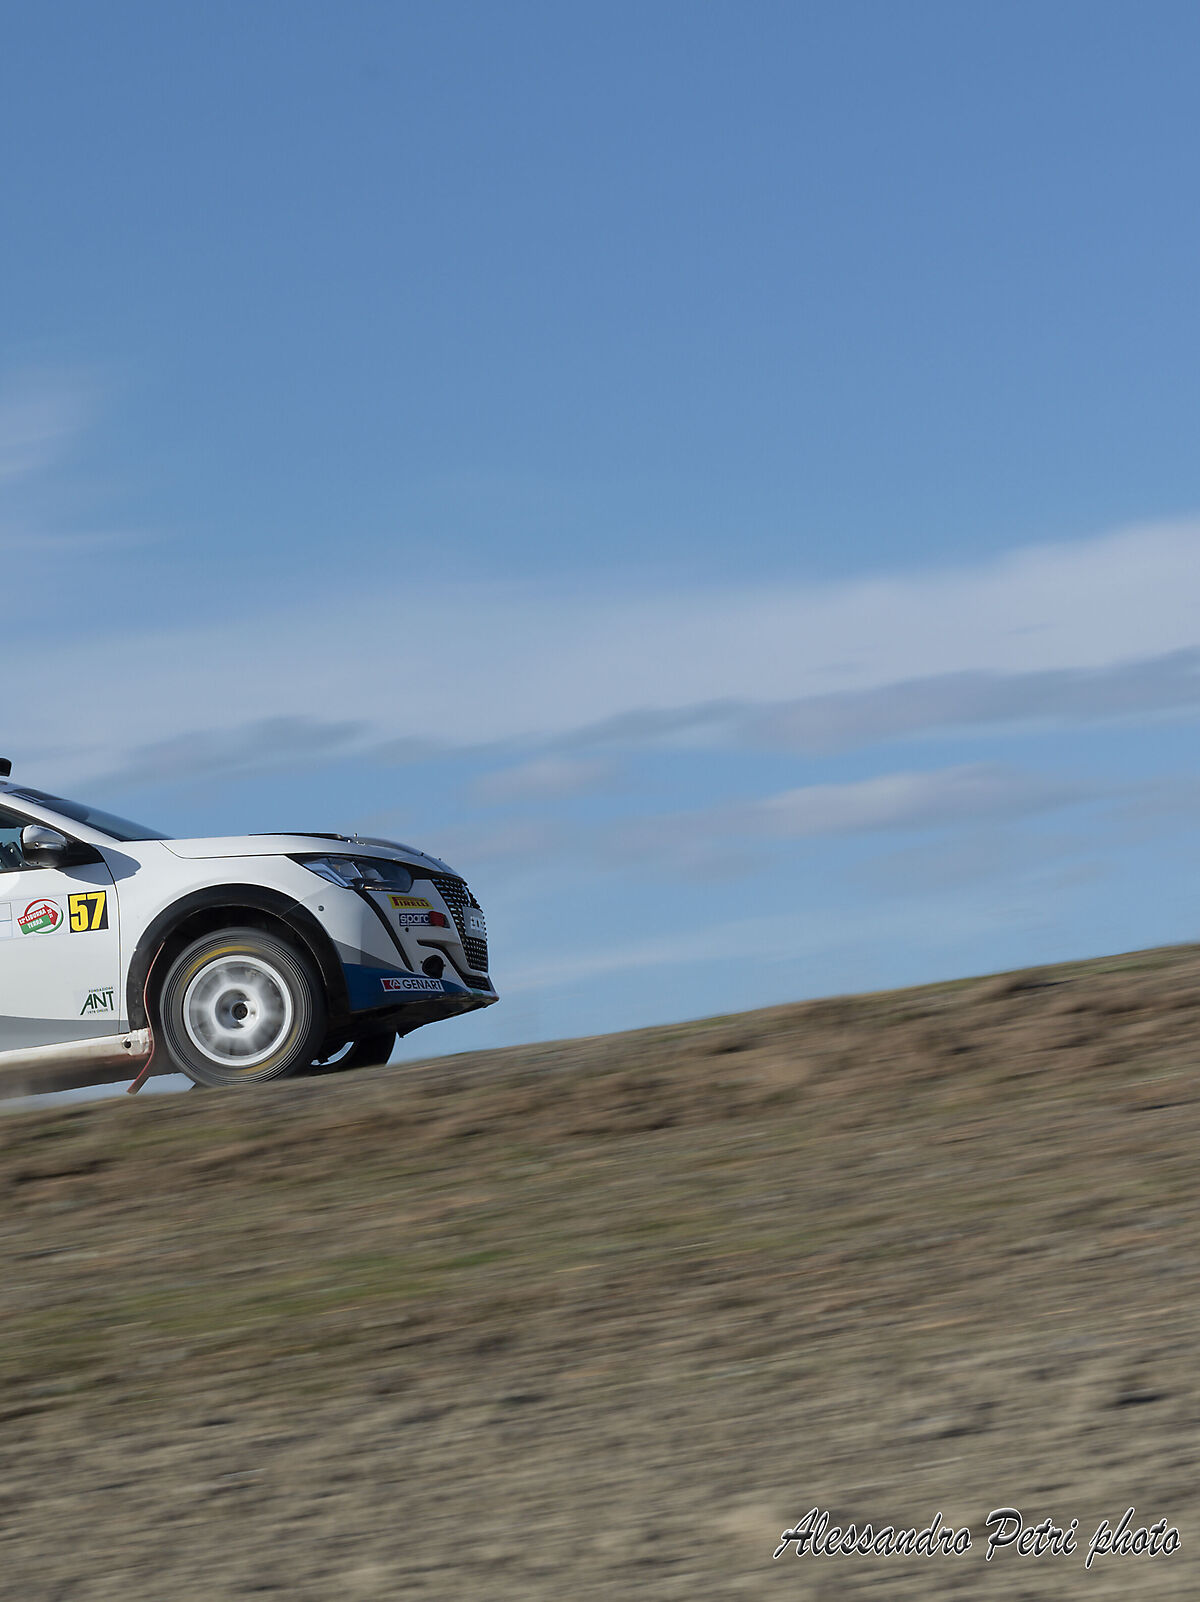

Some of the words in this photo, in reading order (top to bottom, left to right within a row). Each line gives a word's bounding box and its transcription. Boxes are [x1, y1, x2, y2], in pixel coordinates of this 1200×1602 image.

[392, 896, 429, 907] PIRELLI
[69, 892, 105, 931] 57
[400, 914, 430, 925] sparc
[402, 979, 442, 990] GENART
[80, 991, 114, 1015] ANT
